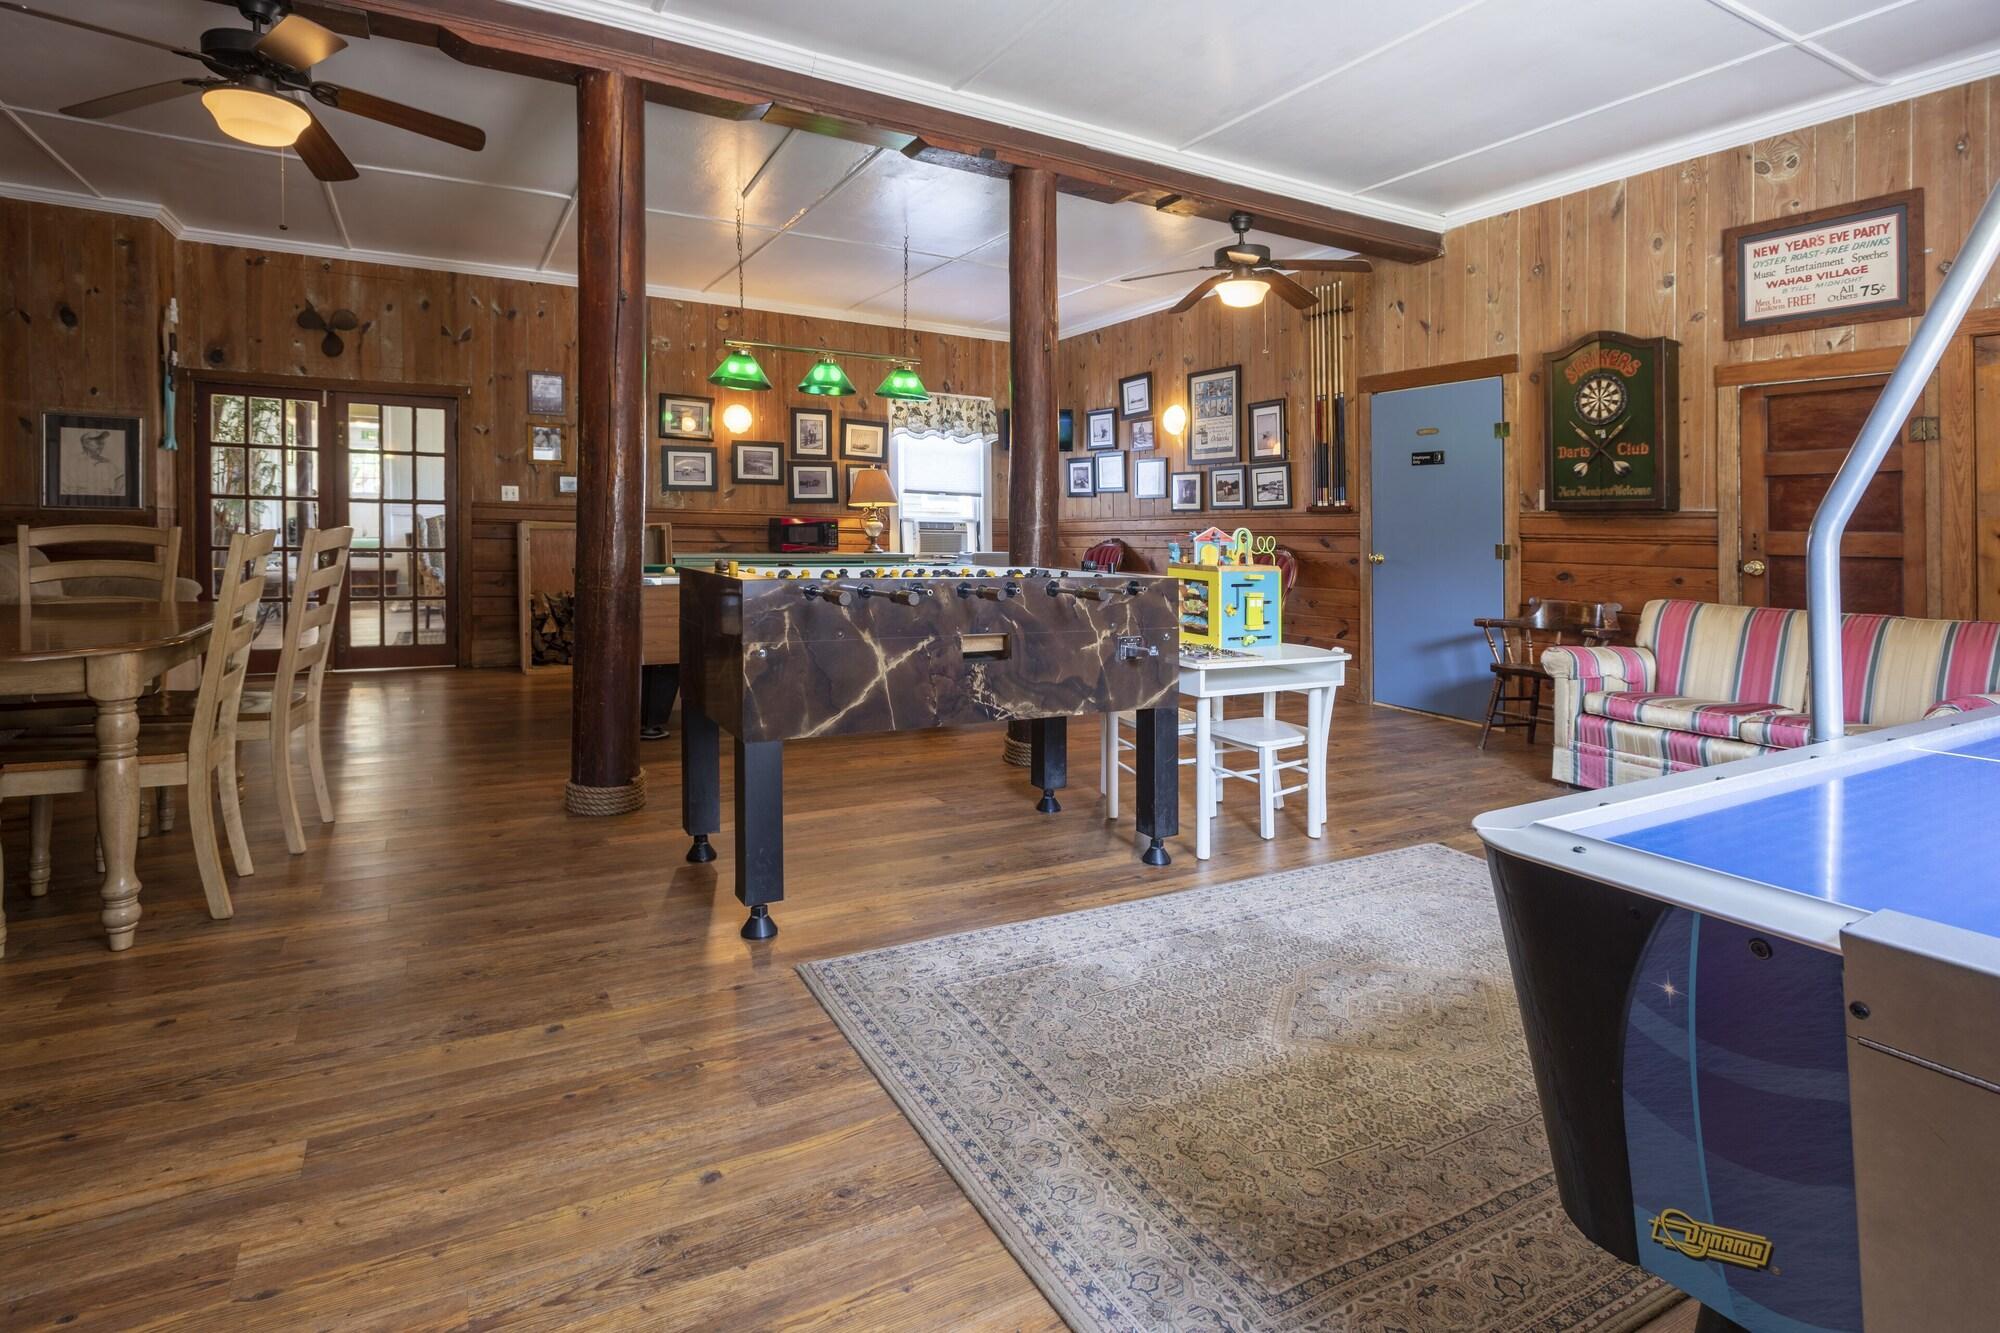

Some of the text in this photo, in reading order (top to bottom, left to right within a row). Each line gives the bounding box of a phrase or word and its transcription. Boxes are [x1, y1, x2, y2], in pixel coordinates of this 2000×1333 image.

[1753, 223, 1891, 258] NEW YEAR'S EVE PARTY
[1752, 256, 1786, 269] OYSTER
[1851, 237, 1891, 251] DRINKS
[1753, 250, 1888, 280] Music Entertainment Speeches
[1766, 265, 1869, 289] WAHAB VILLAGE
[1815, 276, 1863, 288] MIDNIGHT
[1840, 286, 1854, 294] All
[1787, 294, 1816, 308] FREE!
[1828, 293, 1857, 303] Others
[1755, 303, 1785, 313] Uniform
[1558, 442, 1649, 459] Darts Club
